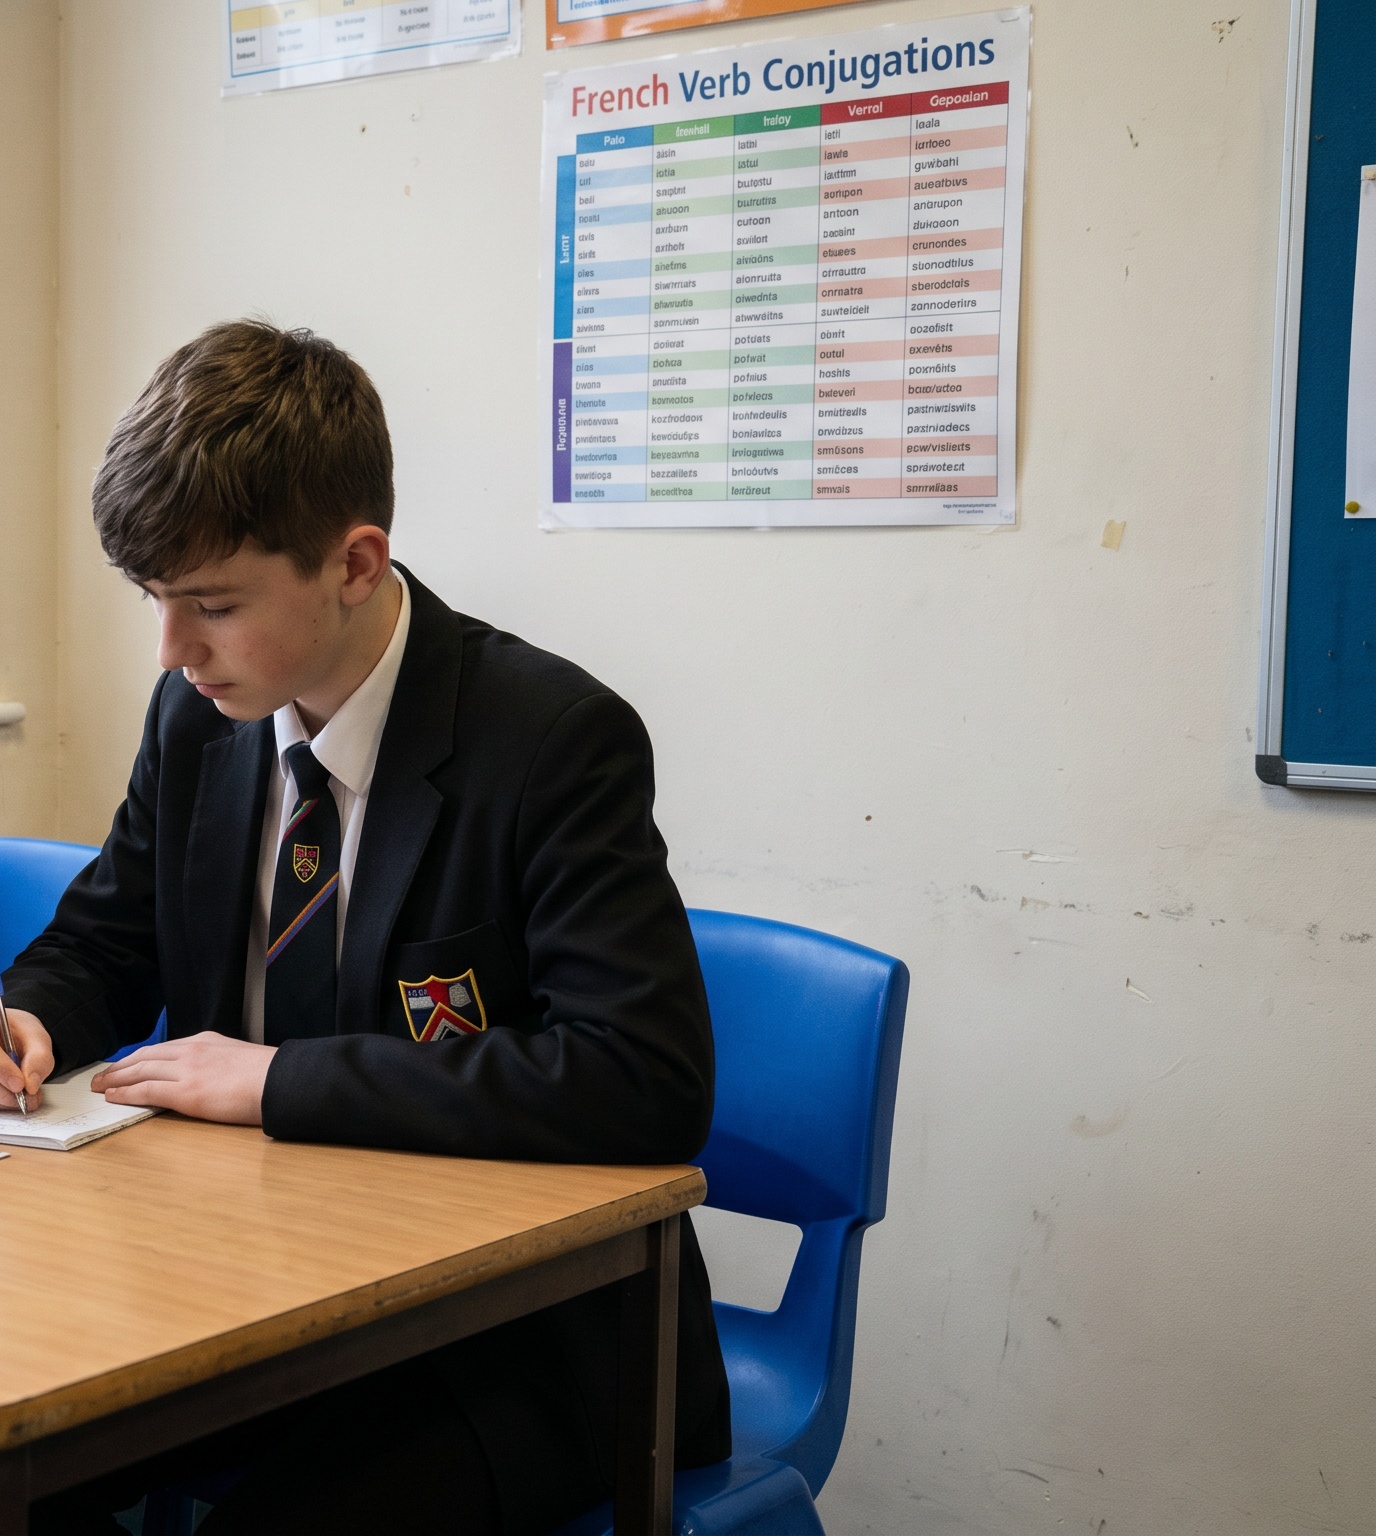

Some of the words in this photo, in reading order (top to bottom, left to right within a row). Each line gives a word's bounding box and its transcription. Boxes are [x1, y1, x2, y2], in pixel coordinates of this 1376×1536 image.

[571, 73, 669, 117] French
[679, 62, 750, 103] Verb
[762, 37, 995, 93] Conjugations
